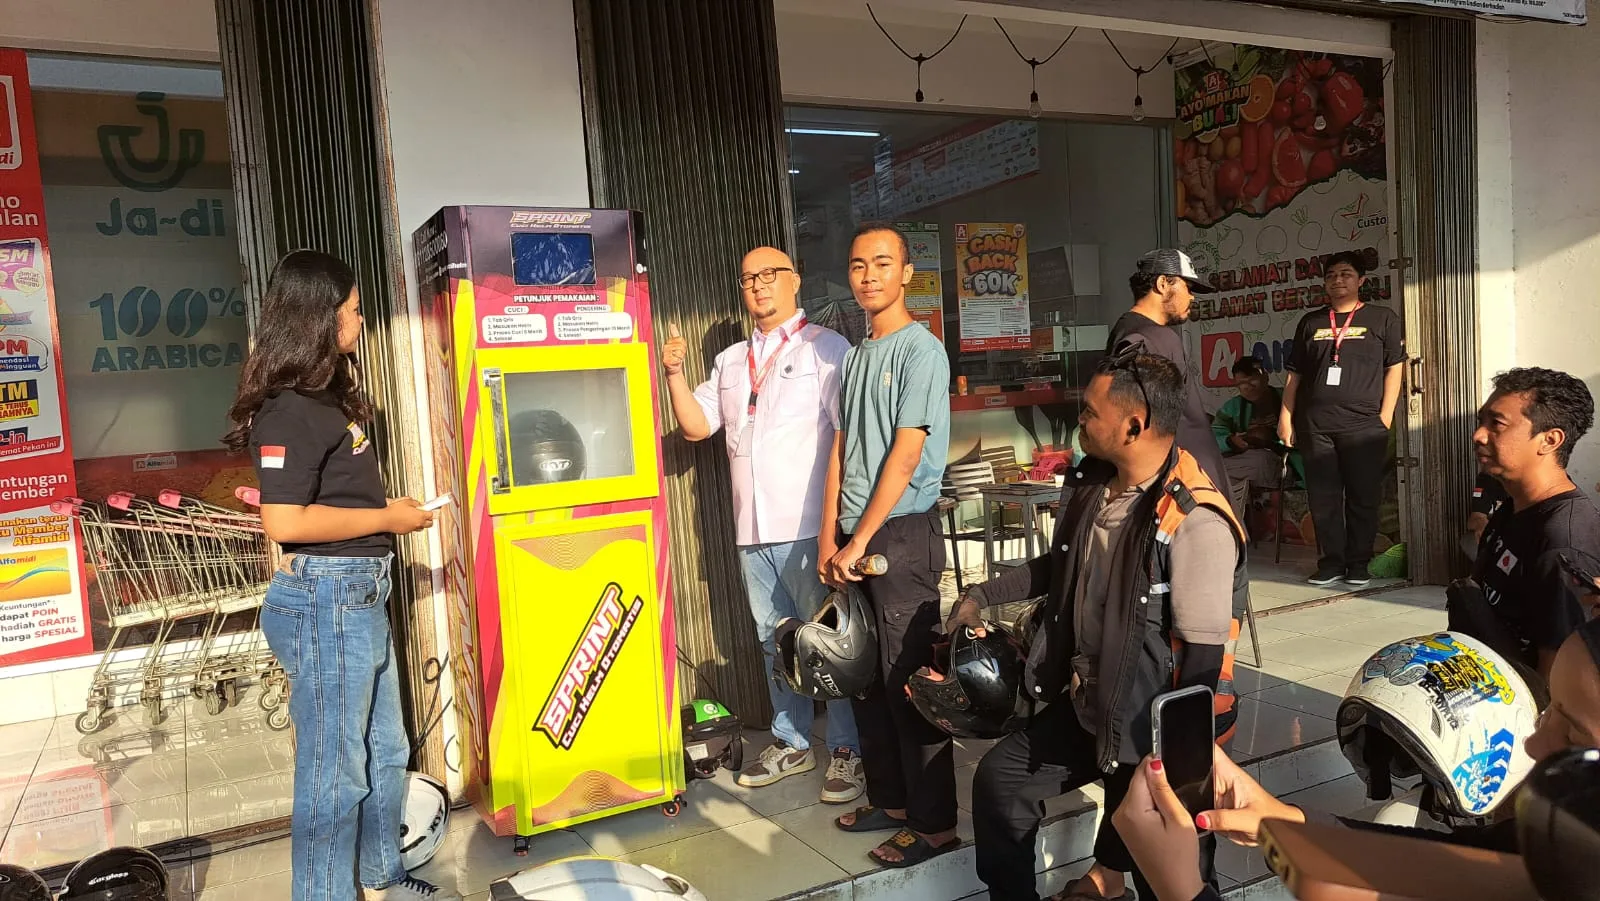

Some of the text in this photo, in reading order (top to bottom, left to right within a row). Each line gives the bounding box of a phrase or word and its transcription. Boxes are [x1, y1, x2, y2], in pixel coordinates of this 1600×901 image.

[1180, 99, 1204, 119] AYO
[510, 211, 591, 224] SPRINT
[1357, 216, 1387, 229] Custo
[968, 234, 1019, 254] CASH
[966, 253, 1017, 275] BACK
[1208, 261, 1291, 292] SELAMAT
[514, 295, 552, 303] PETUNJUK
[553, 294, 596, 302] PEMAKAIAN
[89, 285, 247, 341] 100%
[91, 343, 246, 372] ARABICA
[5, 401, 29, 410] TERUS
[22, 442, 46, 453] Pekan
[47, 440, 57, 448] ini
[1, 487, 55, 500] ember
[38, 514, 69, 523] terus
[13, 523, 69, 535] Member
[13, 532, 70, 546] Alfamidi
[0, 608, 59, 622] dapat POIN
[0, 616, 77, 632] hadiah GRATIS
[1, 626, 78, 642] harga SPESIAL
[538, 585, 623, 740] SPRINT
[562, 597, 643, 748] CUCI HELM OTOMATIS
